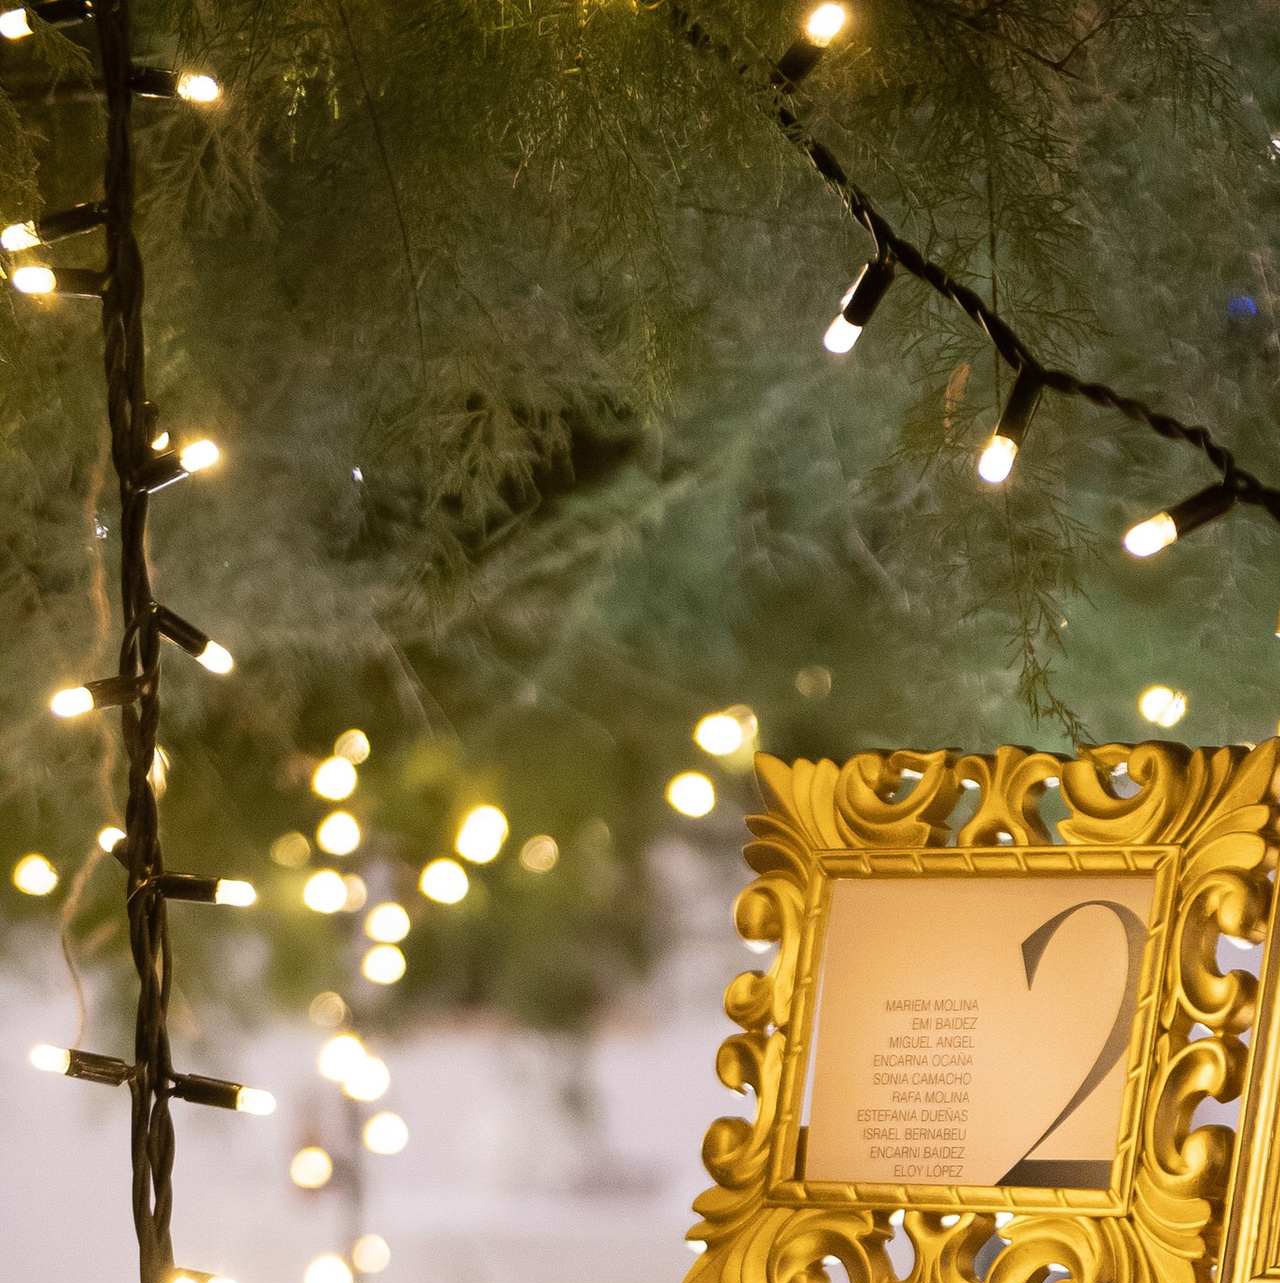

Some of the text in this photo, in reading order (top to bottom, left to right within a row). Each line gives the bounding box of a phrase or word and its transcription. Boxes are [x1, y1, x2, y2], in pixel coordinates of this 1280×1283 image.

[886, 999, 979, 1011] MARIEM MOLINA
[912, 1018, 978, 1030] EMI BAIDEZ
[889, 1036, 931, 1048] MIGUEL
[994, 899, 1148, 1187] 2
[874, 1052, 973, 1066] ENCARNA OCAÑA
[874, 1073, 971, 1085] SONIA CAMACHO
[892, 1091, 970, 1103] RAFA MOLINA
[921, 1108, 968, 1121] DUEÑAS
[863, 1128, 966, 1140] ISRAEL BERNABEU
[870, 1147, 965, 1159] ENCARNI BAIDEZ
[894, 1162, 963, 1177] ELOY LÓPEZ
